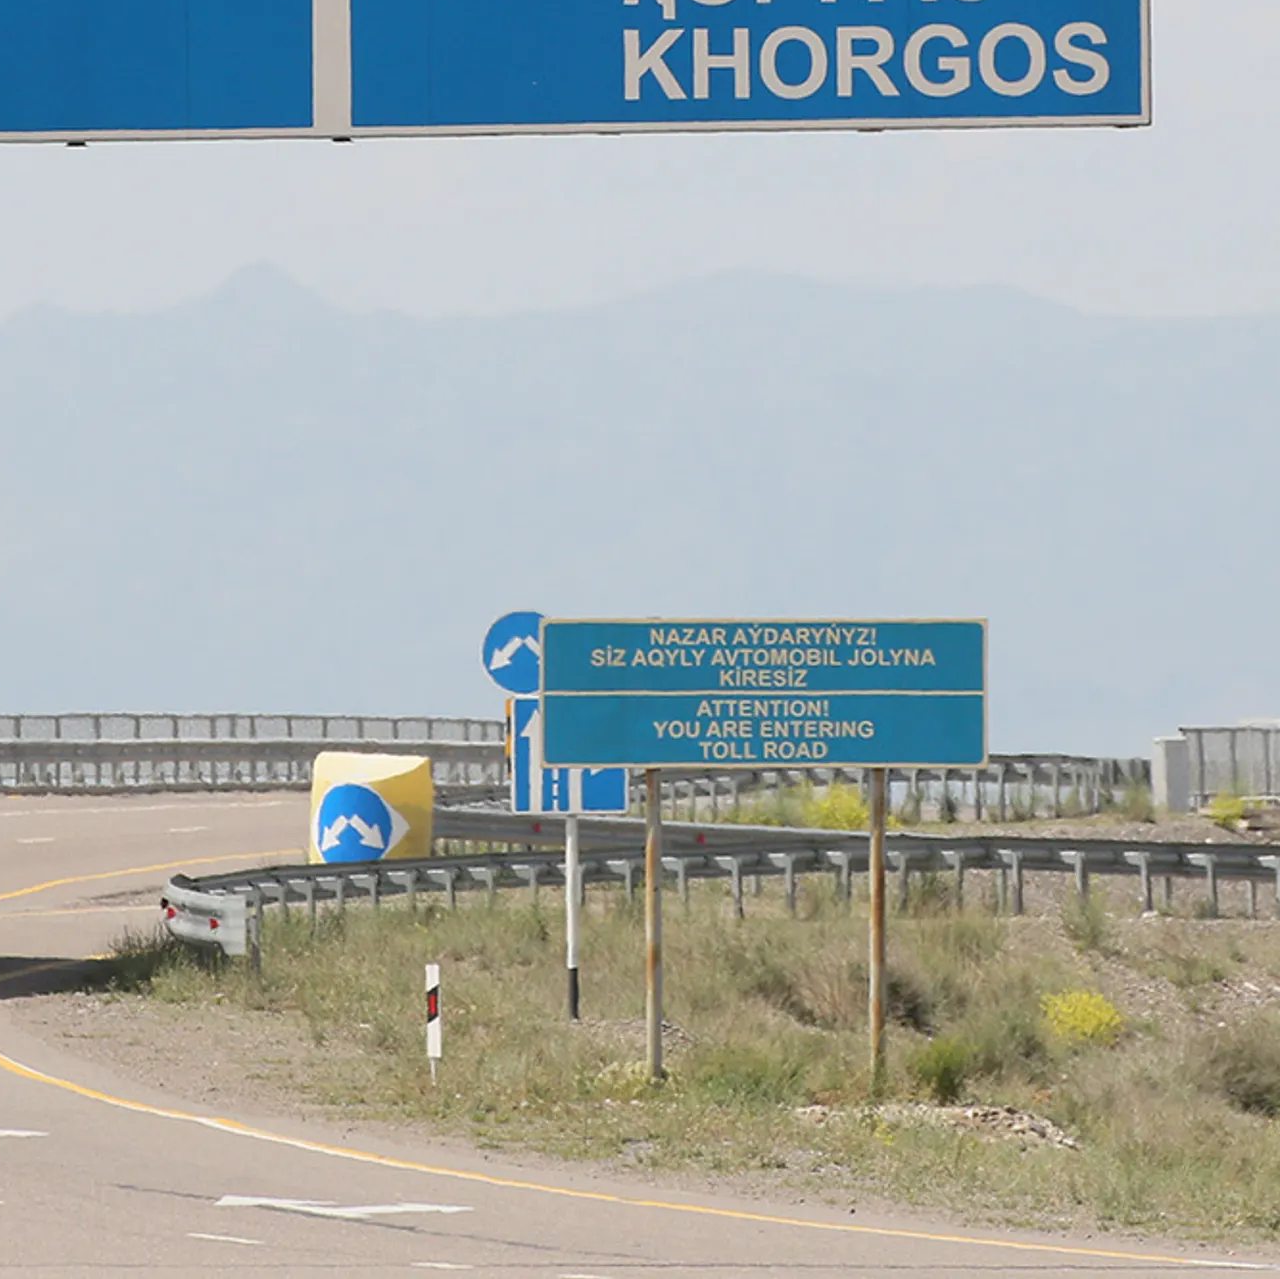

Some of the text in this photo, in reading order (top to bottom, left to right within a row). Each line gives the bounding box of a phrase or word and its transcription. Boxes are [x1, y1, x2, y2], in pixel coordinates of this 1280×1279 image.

[624, 22, 1109, 100] KHORGOS
[651, 628, 726, 645] NAZAR
[632, 649, 705, 666] AQYLY
[848, 649, 935, 665] JOLYNA
[697, 700, 828, 717] ATTENTION!
[654, 720, 874, 738] YOU ARE ENTERING
[700, 741, 827, 759] TOLL ROAD
